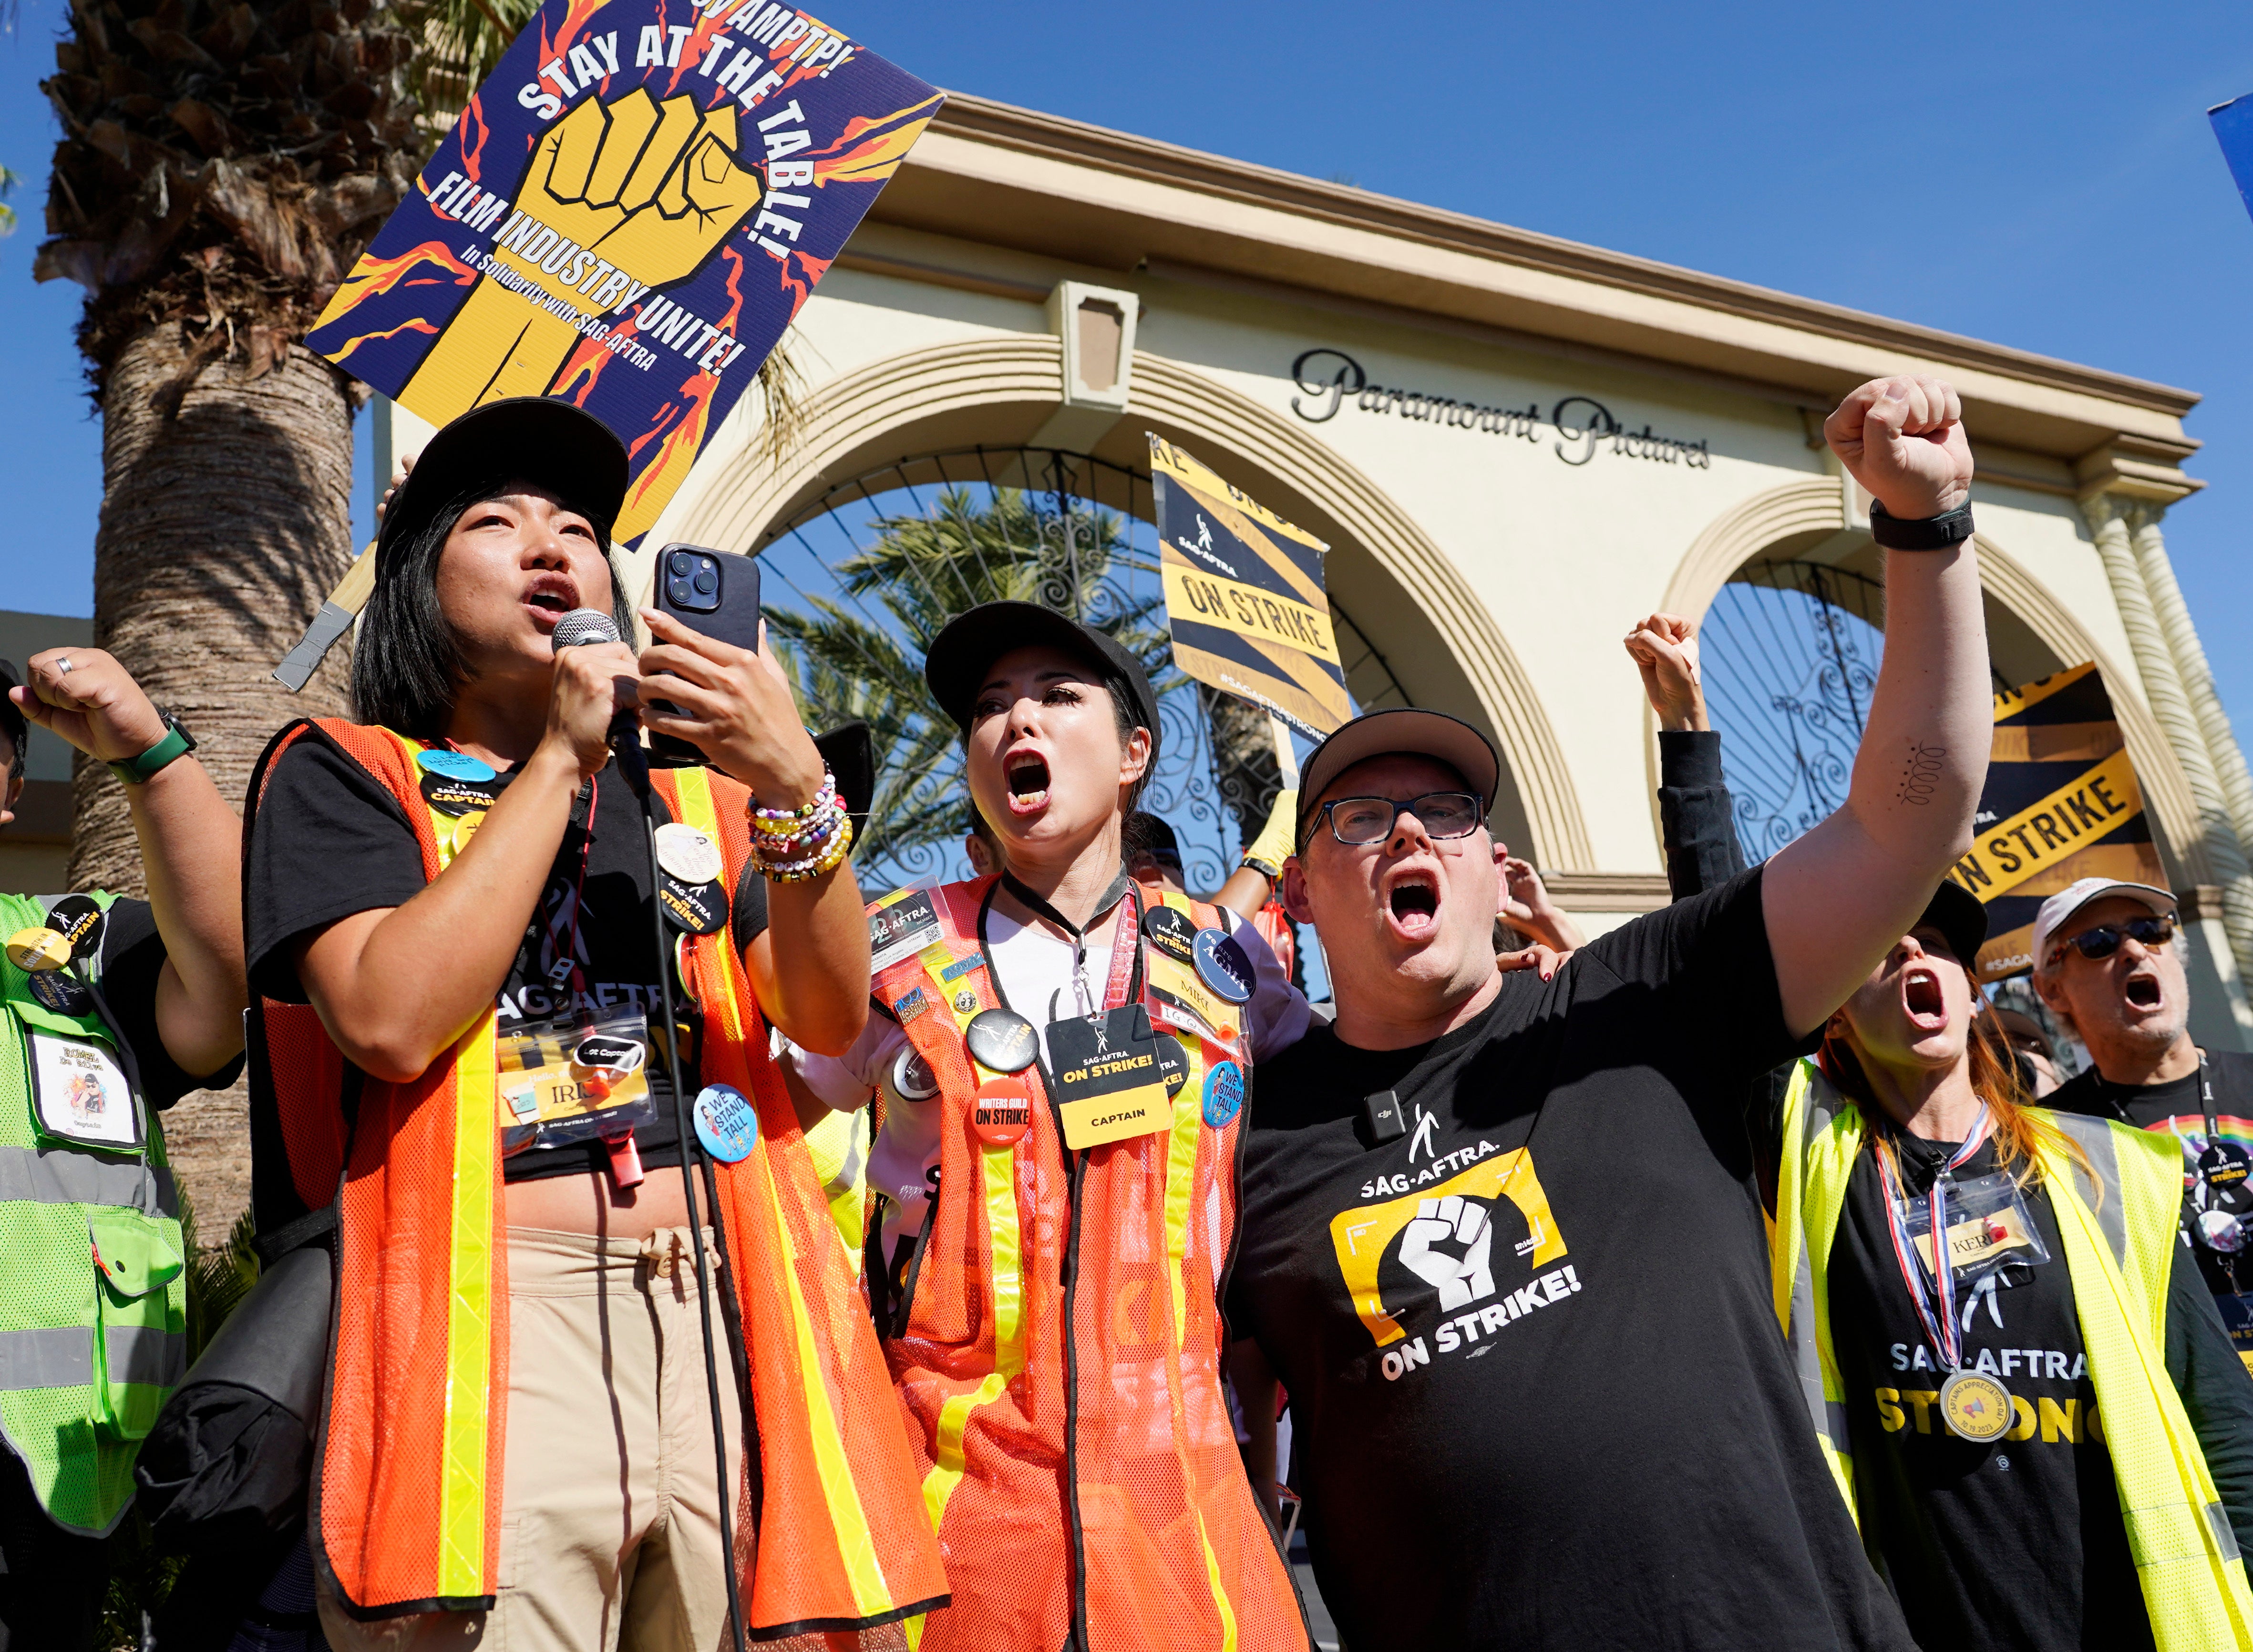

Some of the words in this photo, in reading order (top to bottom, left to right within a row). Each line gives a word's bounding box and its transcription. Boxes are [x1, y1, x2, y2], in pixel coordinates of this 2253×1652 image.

[725, 0, 855, 79] AMPTP!
[518, 30, 620, 121] STAY
[636, 24, 693, 68] AT
[698, 32, 784, 110] THE
[749, 99, 815, 259] TABLE!
[426, 172, 502, 233] FILM
[492, 209, 654, 322] INDUSTRY
[638, 288, 746, 377] UNITE!
[461, 244, 481, 265] In
[477, 255, 547, 307] Solidarity
[545, 294, 580, 326] with
[575, 312, 657, 371] SAG-AFTRA
[1291, 349, 1543, 443] Paramount
[1553, 396, 1710, 470] Pictures
[1182, 575, 1230, 620] ON
[1229, 589, 1328, 651] STRIKE
[1988, 775, 2126, 872] STRIKE
[660, 889, 706, 931] STRIKE!
[681, 899, 691, 909] ON
[916, 914, 933, 925] MEMBER
[20, 937, 41, 959] STRENGTH
[24, 933, 61, 968] SOLIDARITY
[1205, 932, 1216, 944] we
[1218, 945, 1233, 961] are
[1203, 945, 1252, 993] AGMA
[34, 975, 61, 1006] STRIKE!
[1181, 980, 1209, 1011] MIKI
[59, 1056, 72, 1065] De
[76, 1059, 103, 1071] Silva
[63, 1047, 99, 1063] ROMEL
[1063, 1068, 1090, 1084] ON
[1091, 1054, 1153, 1078] STRIKE!
[1219, 1082, 1242, 1103] STAND
[1226, 1071, 1239, 1086] WE
[709, 1091, 729, 1111] WE
[714, 1096, 745, 1128] STAND
[979, 1098, 1008, 1108] WRITERS
[1008, 1098, 1027, 1108] GUILD
[1217, 1096, 1232, 1113] TALL
[1378, 1109, 1392, 1118] dji
[724, 1116, 748, 1139] TALL
[976, 1109, 990, 1125] ON
[993, 1109, 1029, 1125] STRIKE
[1091, 1108, 1146, 1127] CAPTAIN
[1382, 1336, 1430, 1381] ON
[1435, 1265, 1582, 1353] STRIKE!
[1951, 1386, 1964, 1415] CAPTAINS
[1964, 1381, 2004, 1407] APPRECIATION
[1996, 1408, 2004, 1422] DAY
[1961, 1420, 1994, 1433] 10.19.2023
